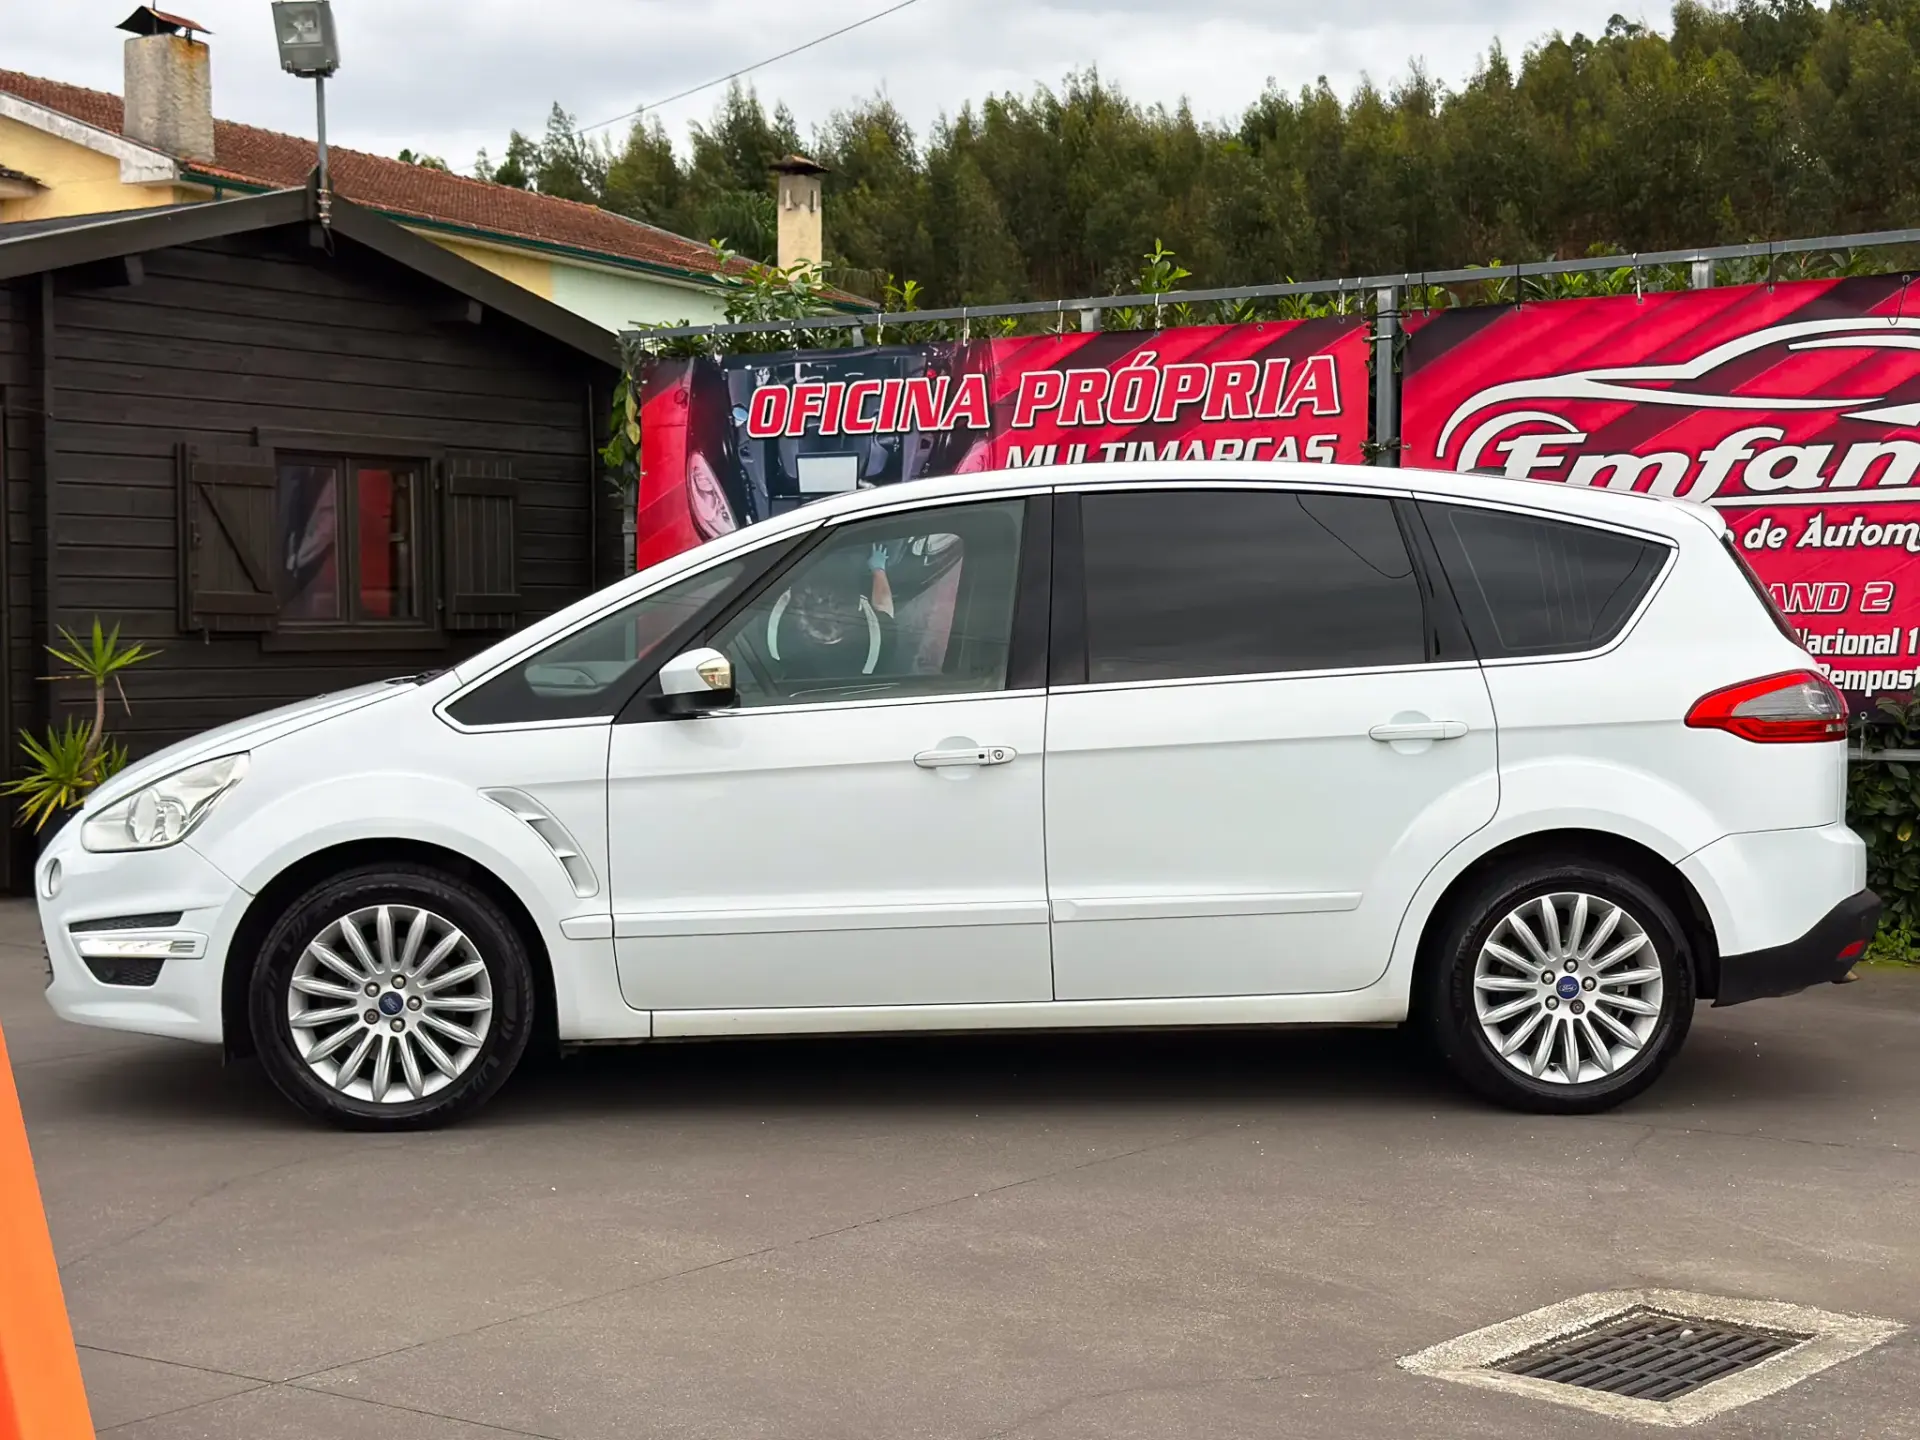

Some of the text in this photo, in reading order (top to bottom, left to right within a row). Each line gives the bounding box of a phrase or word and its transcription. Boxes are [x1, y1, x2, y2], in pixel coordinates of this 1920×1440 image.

[747, 351, 1341, 438] OFICINA PRÓPRIA
[1744, 518, 1788, 548] de
[1860, 581, 1893, 612] 2
